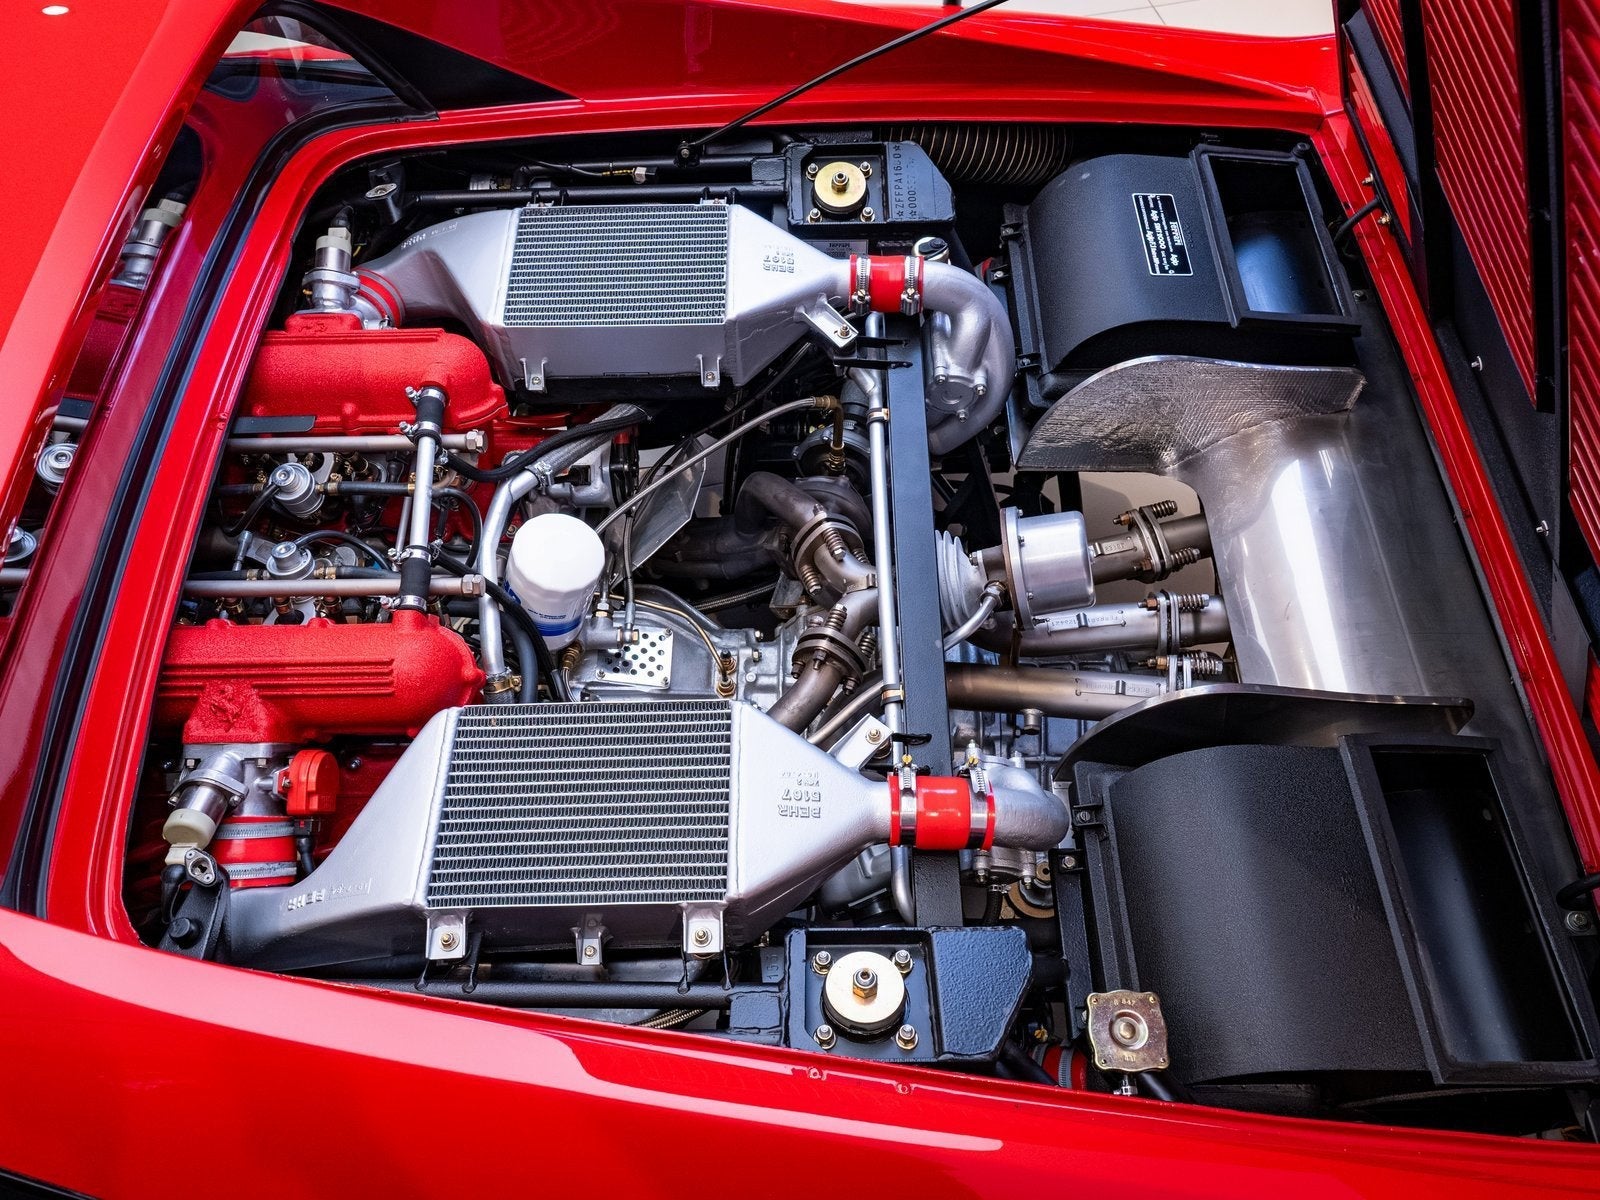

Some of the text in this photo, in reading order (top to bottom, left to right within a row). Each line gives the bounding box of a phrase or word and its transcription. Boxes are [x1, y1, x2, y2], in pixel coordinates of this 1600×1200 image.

[893, 153, 904, 208] ZFFPA160
[1169, 221, 1183, 245] Ferrari
[782, 789, 821, 802] 5167
[778, 805, 820, 818] BEHR
